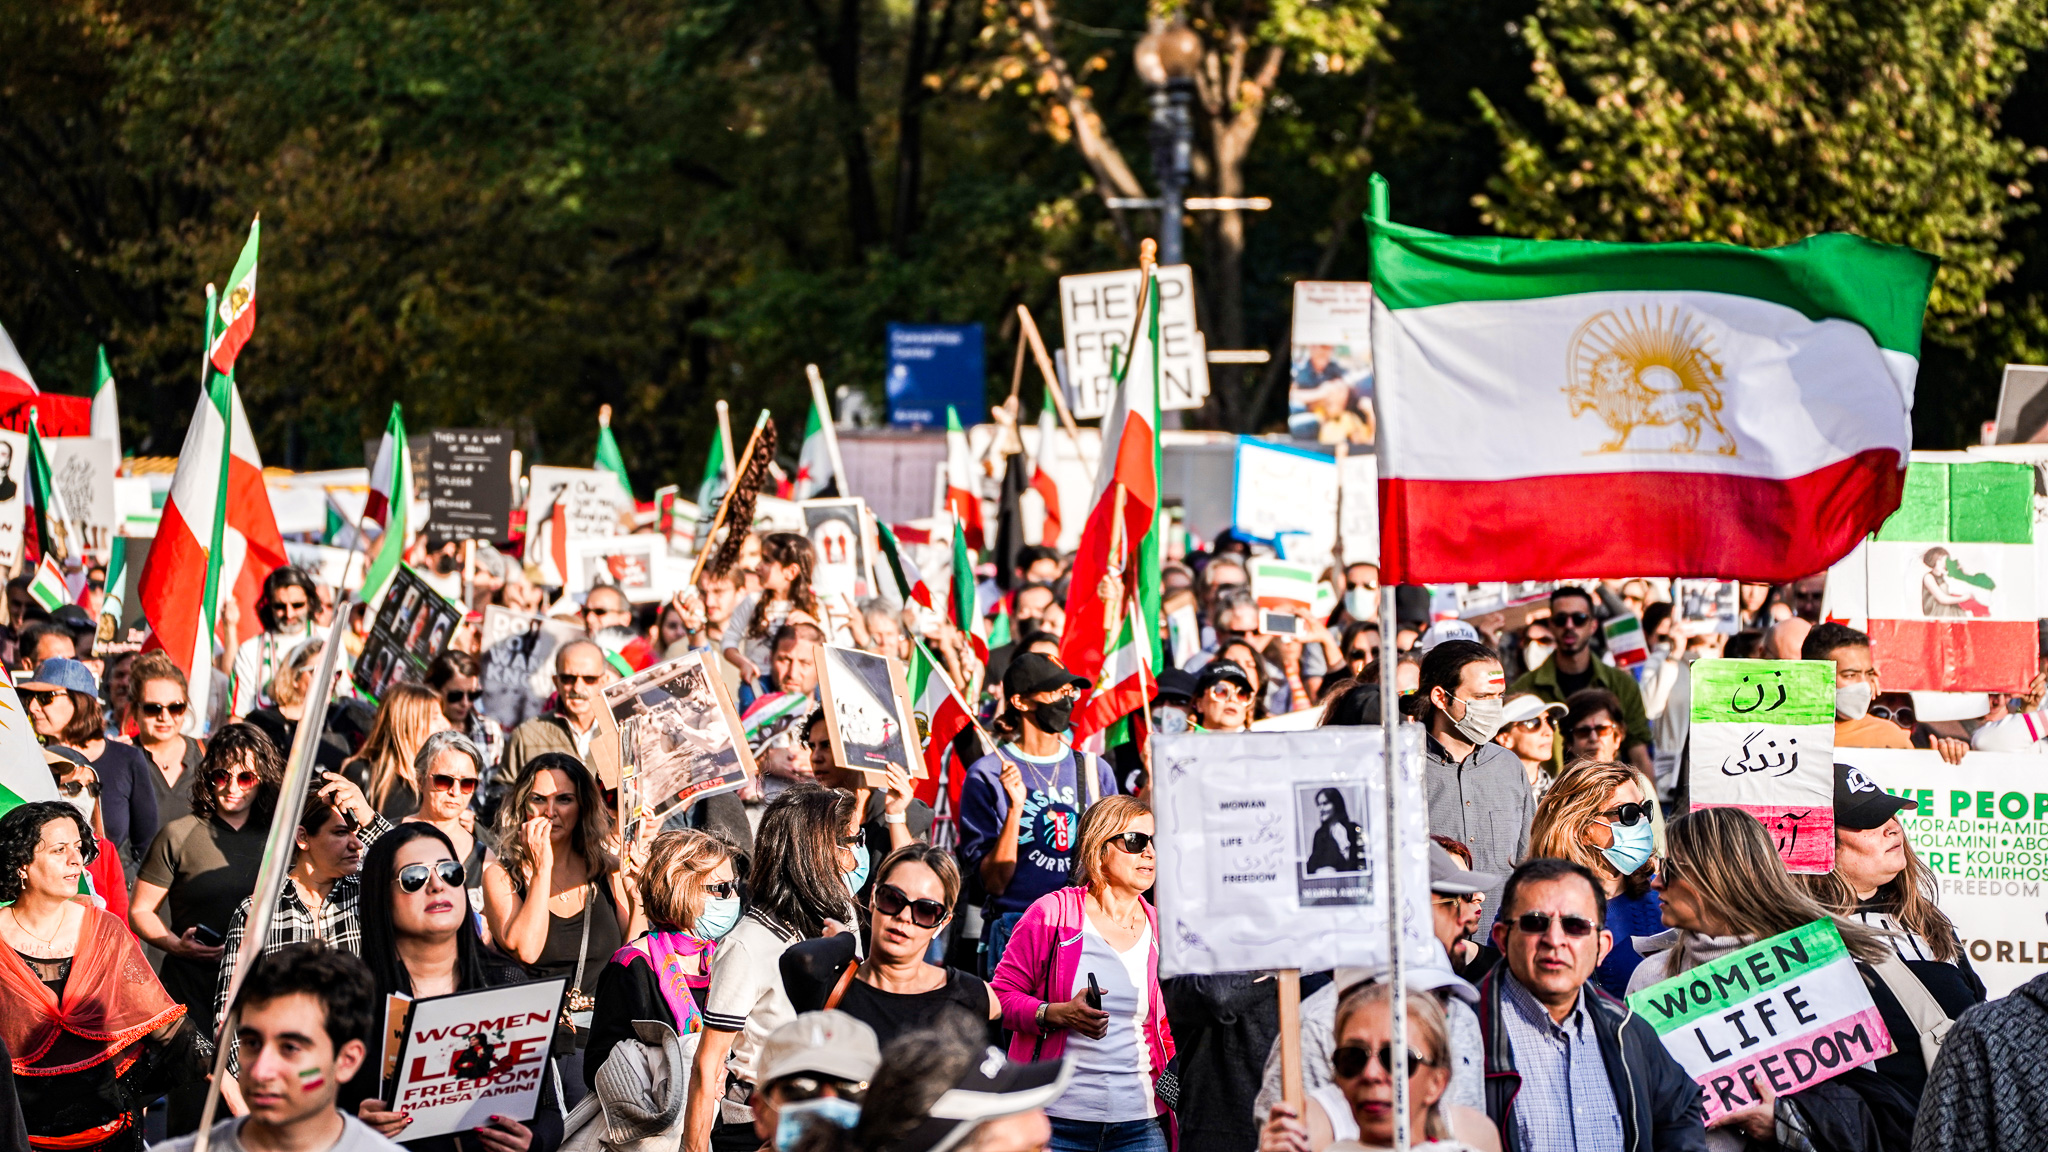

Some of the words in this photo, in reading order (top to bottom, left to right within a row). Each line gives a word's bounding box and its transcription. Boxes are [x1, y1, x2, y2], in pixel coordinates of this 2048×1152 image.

[1075, 322, 1190, 366] FRE
[1731, 670, 1788, 713] زن
[1721, 728, 1799, 778] زندگی
[1018, 786, 1074, 845] KANSAS
[1942, 880, 2040, 898] FREEDOM
[1648, 936, 1809, 1019] WOMEN
[414, 1009, 551, 1044] WOMEN
[1694, 985, 1818, 1063] LIFE
[403, 1067, 541, 1101] FREEDOM
[1699, 1023, 1874, 1121] FREEDOM
[400, 1092, 472, 1113] MAHSA
[479, 1082, 535, 1099] AMINI
